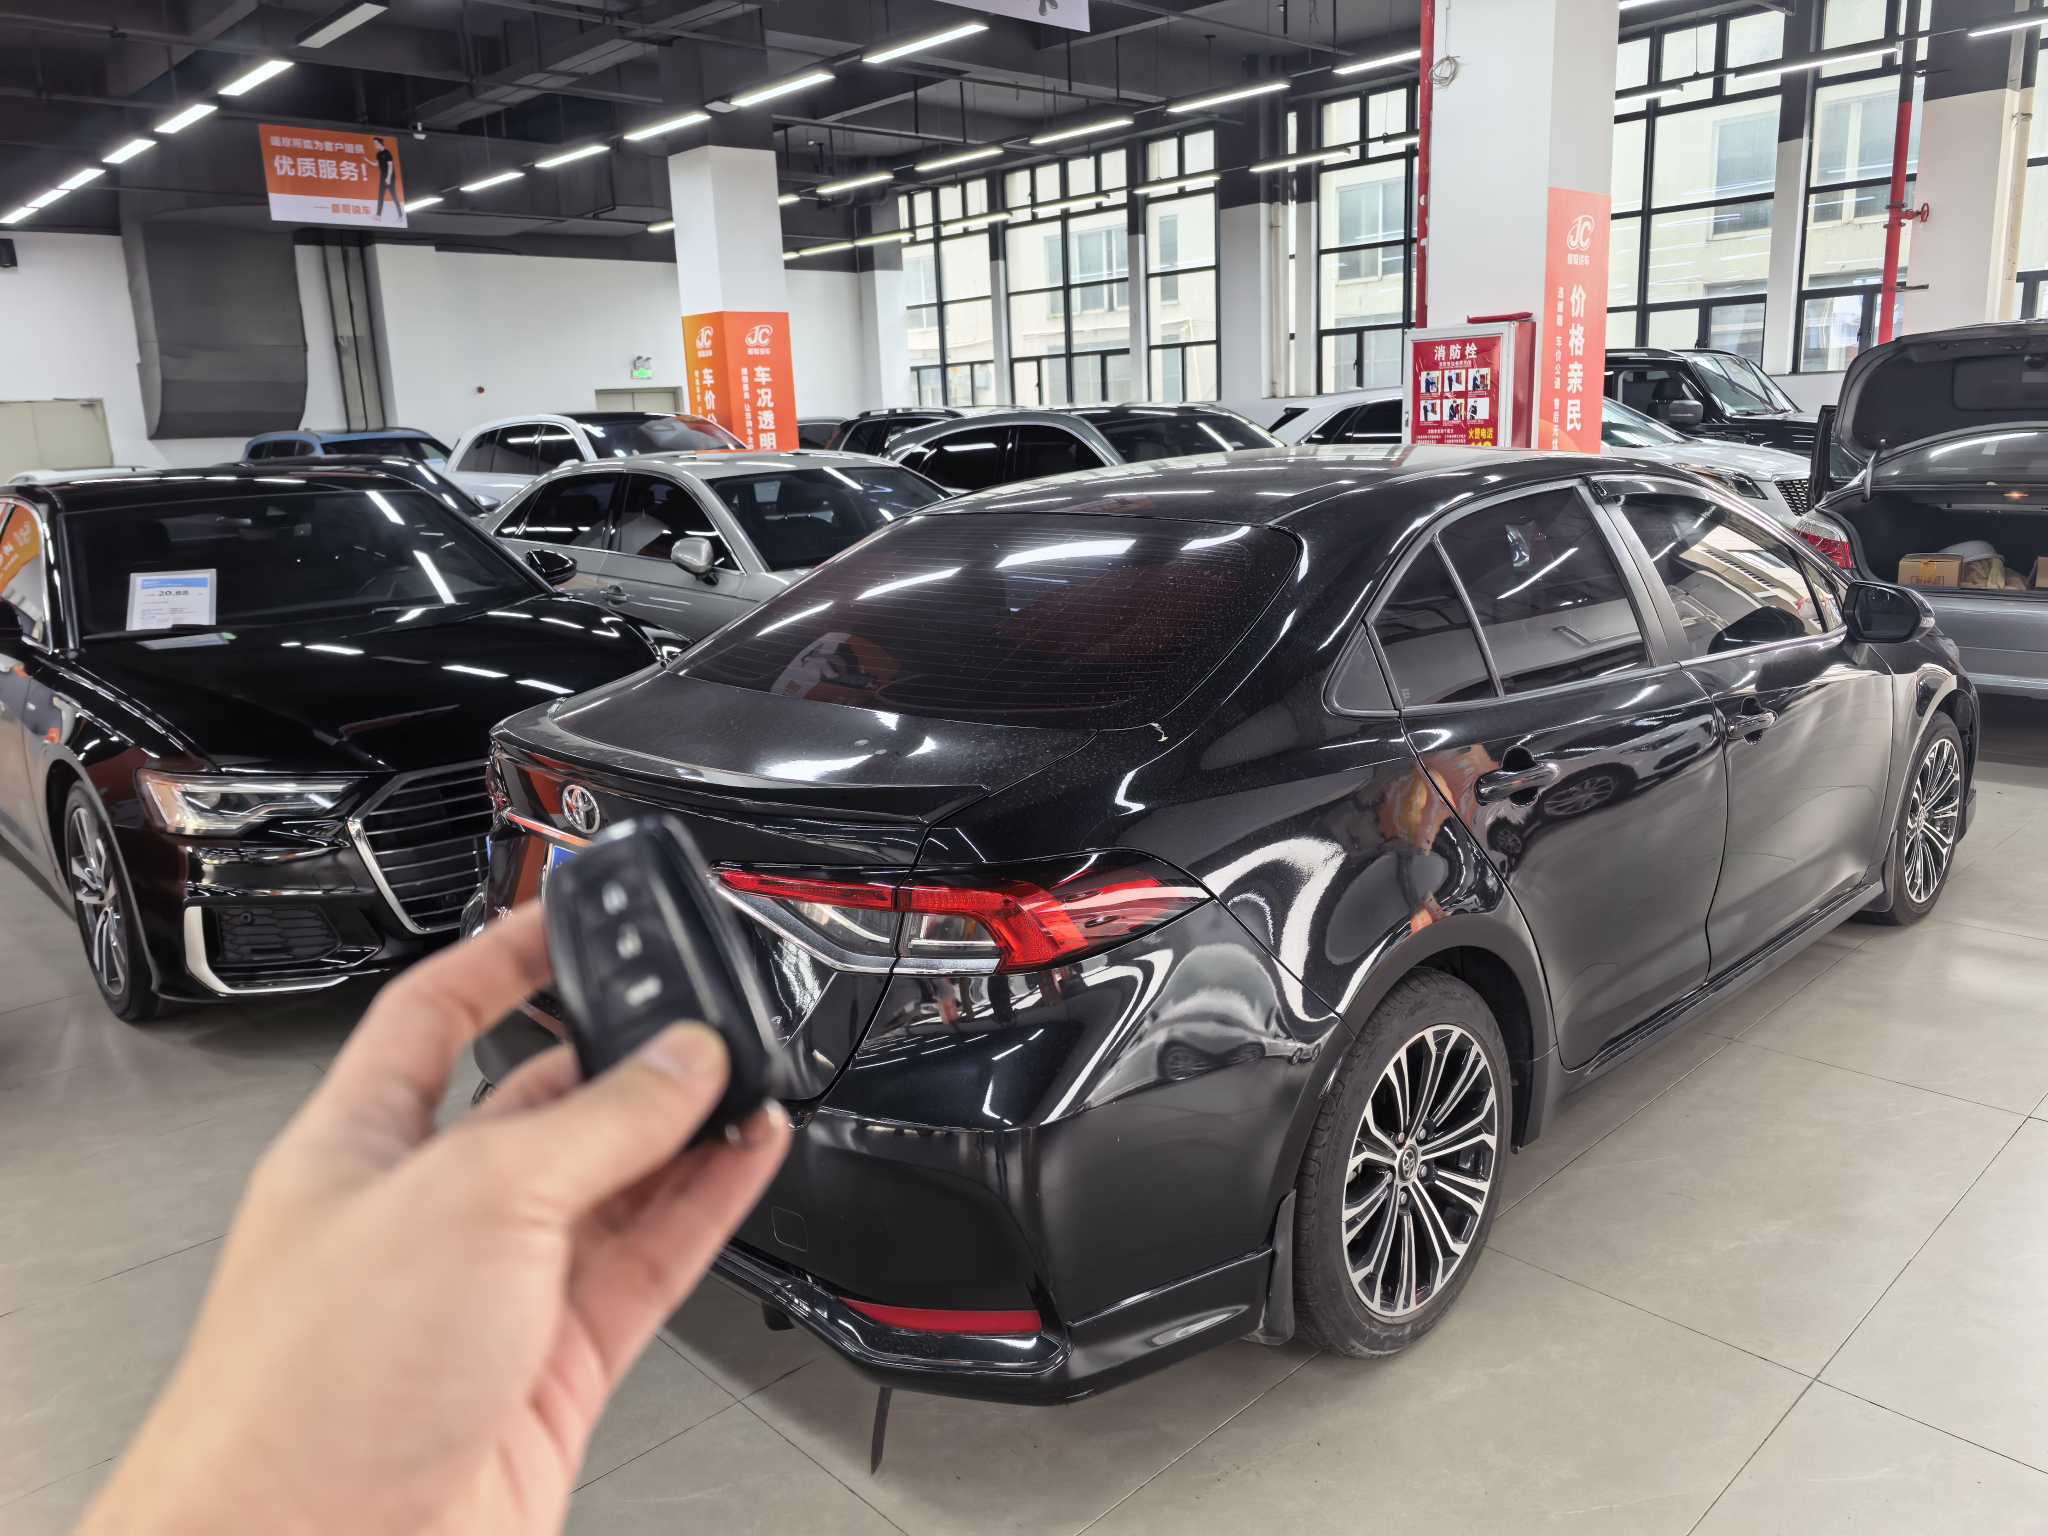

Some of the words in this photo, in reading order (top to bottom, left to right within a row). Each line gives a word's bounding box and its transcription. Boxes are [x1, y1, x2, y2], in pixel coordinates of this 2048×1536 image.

[273, 155, 369, 182] 优质服务!
[745, 324, 773, 347] JC
[1434, 342, 1478, 361] 消防栓
[1566, 284, 1586, 432] 价格亲民
[753, 366, 777, 450] 车况透明
